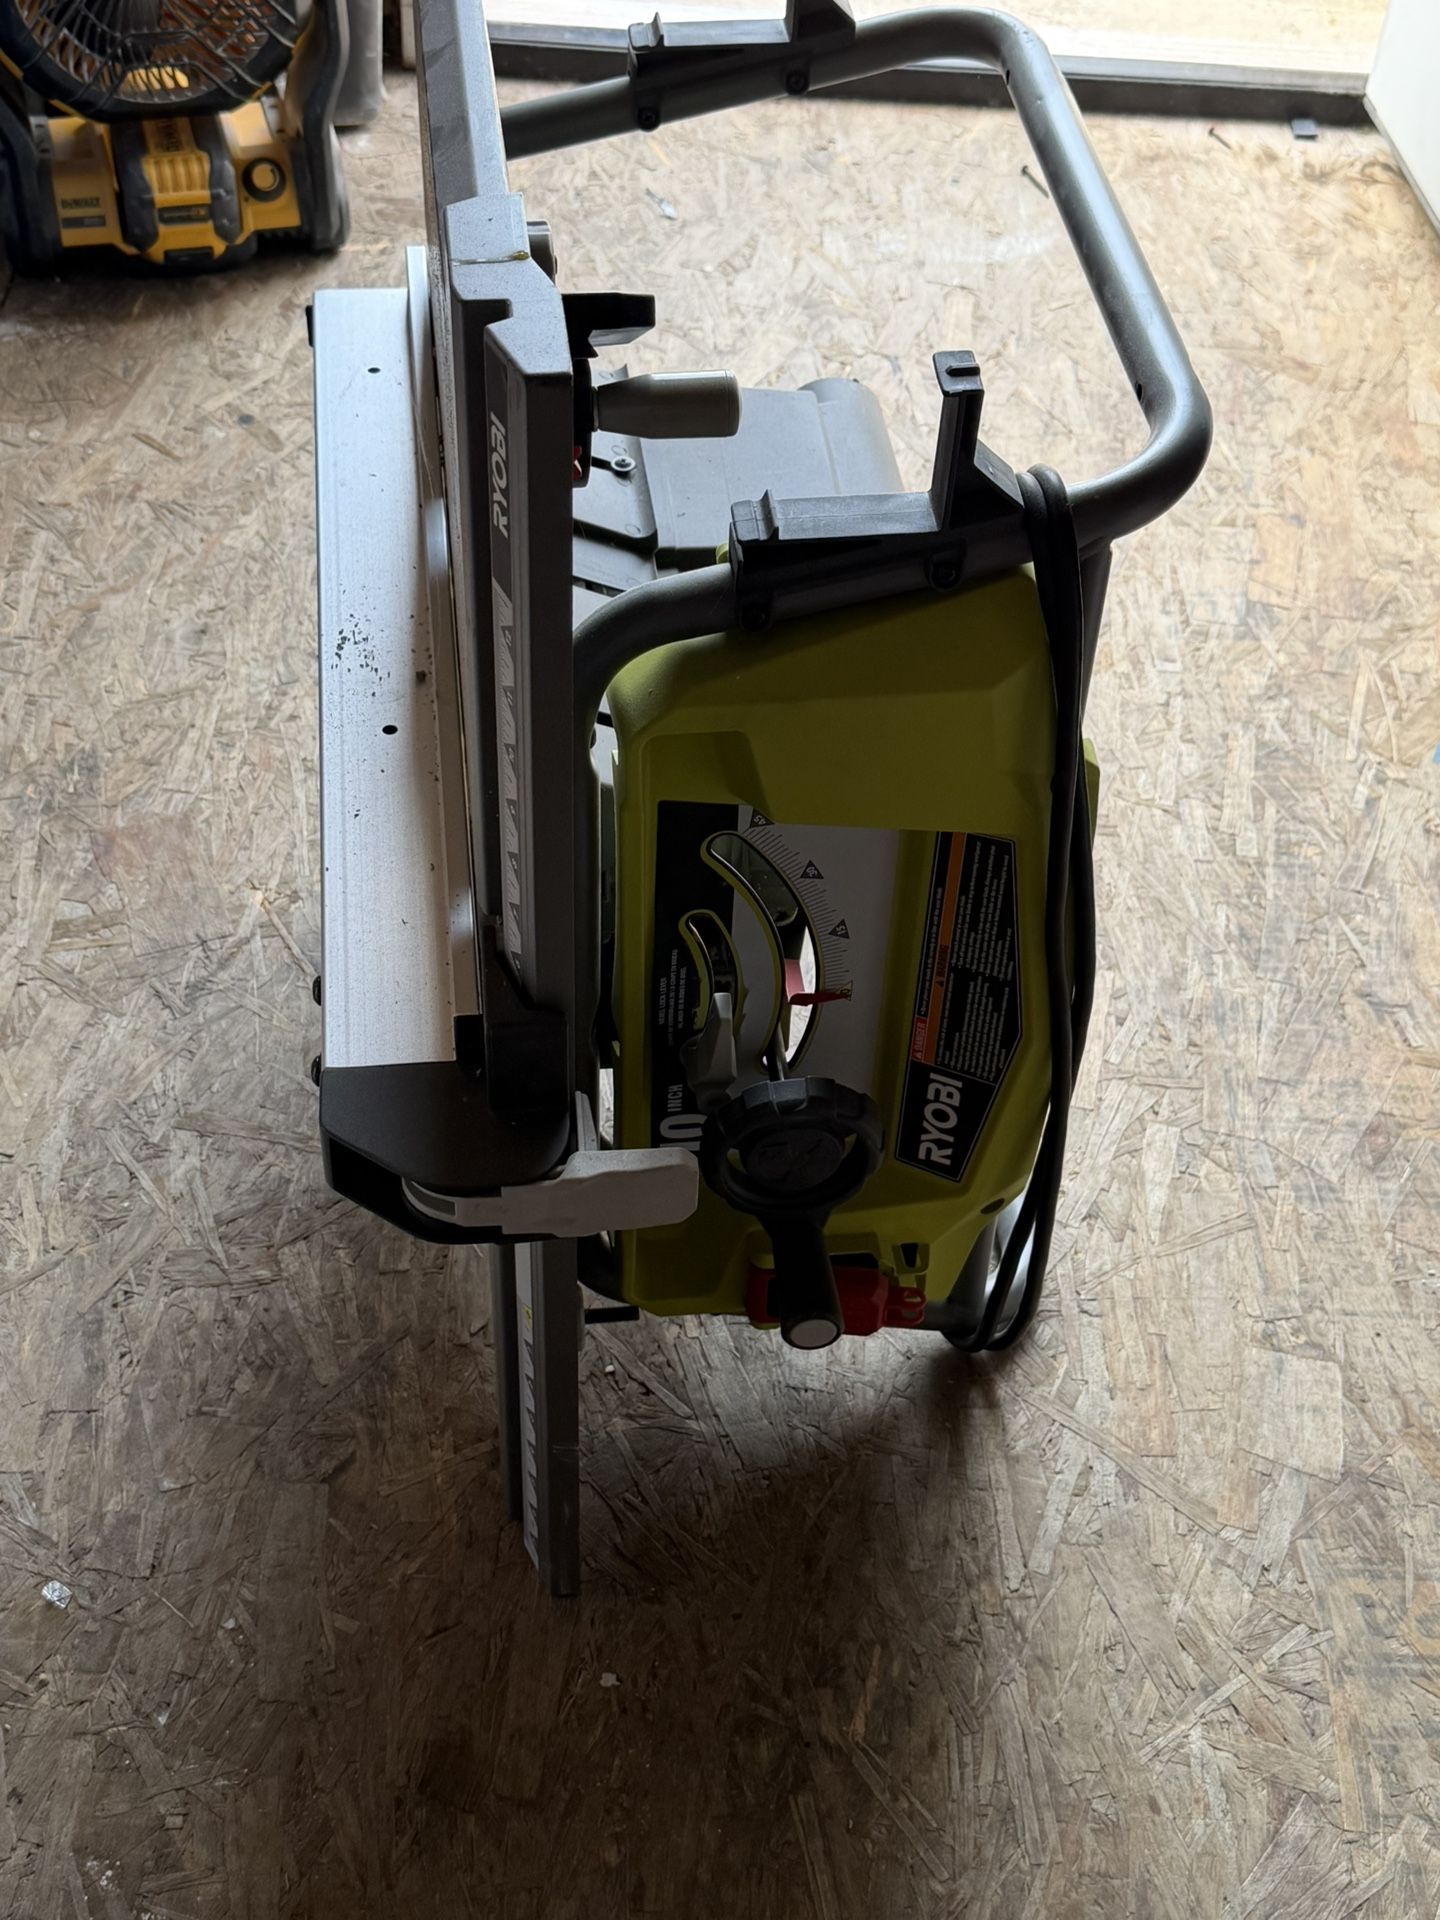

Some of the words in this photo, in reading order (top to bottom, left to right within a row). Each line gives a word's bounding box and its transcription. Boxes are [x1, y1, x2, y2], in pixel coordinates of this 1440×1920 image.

[490, 411, 507, 538] RYOBI
[753, 815, 766, 825] 45
[806, 866, 818, 877] 30
[835, 925, 847, 935] 15
[913, 1022, 926, 1051] DANGER
[667, 1084, 683, 1112] INCH
[917, 1072, 963, 1166] RYOBI
